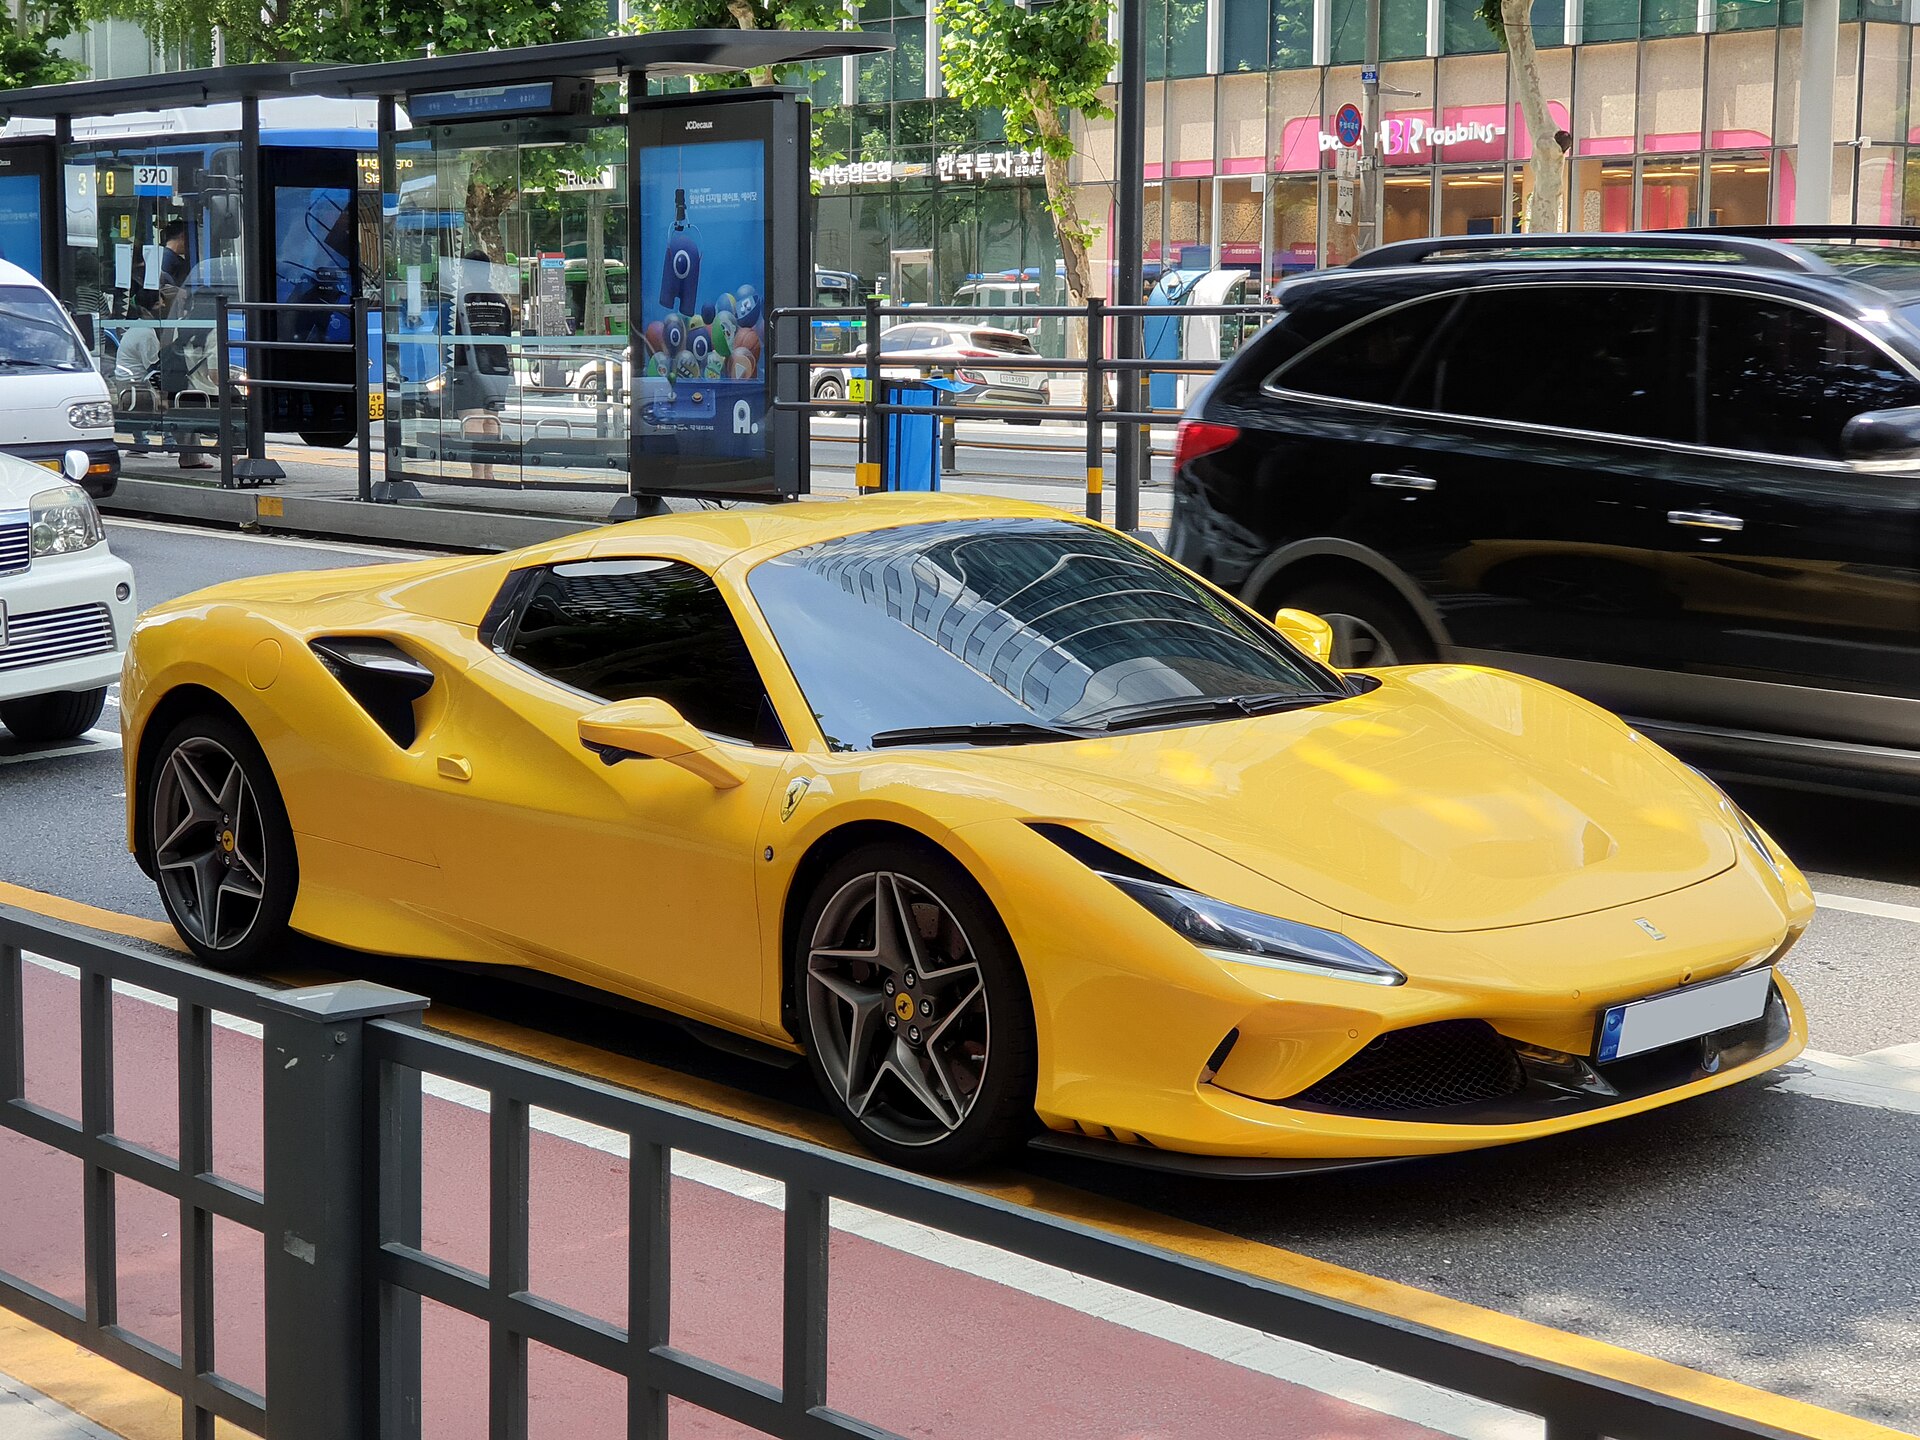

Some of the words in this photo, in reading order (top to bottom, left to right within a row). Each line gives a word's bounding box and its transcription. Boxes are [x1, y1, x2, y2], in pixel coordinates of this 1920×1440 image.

[685, 120, 713, 130] JCDecaux
[1381, 118, 1424, 155] BR
[139, 168, 168, 184] 370
[937, 151, 1013, 181] 한국투자
